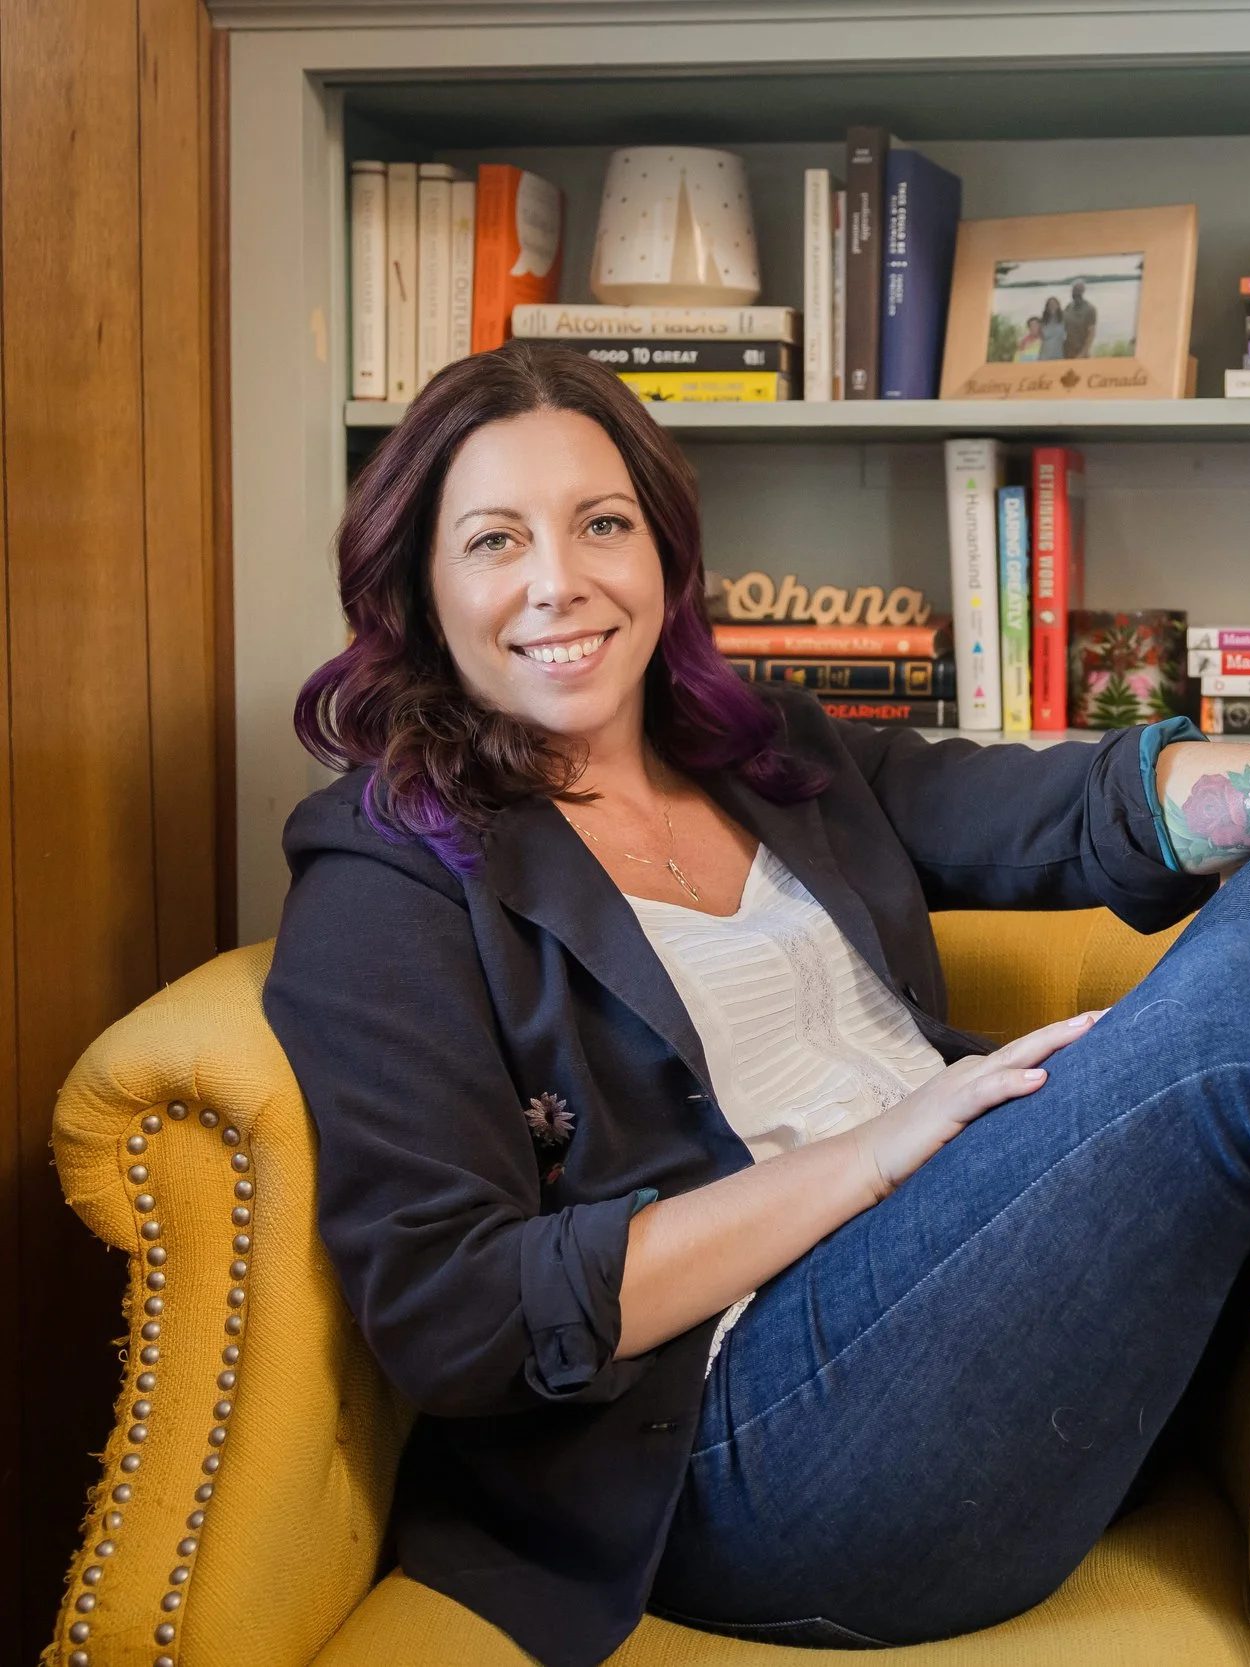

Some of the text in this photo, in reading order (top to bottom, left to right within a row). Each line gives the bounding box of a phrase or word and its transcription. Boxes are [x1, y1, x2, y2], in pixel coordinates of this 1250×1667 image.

[555, 311, 643, 335] Atomic
[652, 349, 699, 365] GREAT
[967, 366, 1149, 399] Rainy Lake Canada
[965, 493, 982, 590] Humankind
[1038, 464, 1055, 598] RETHINKING WORK
[1005, 498, 1025, 630] DARING GREATLY
[722, 571, 931, 626] Ohana
